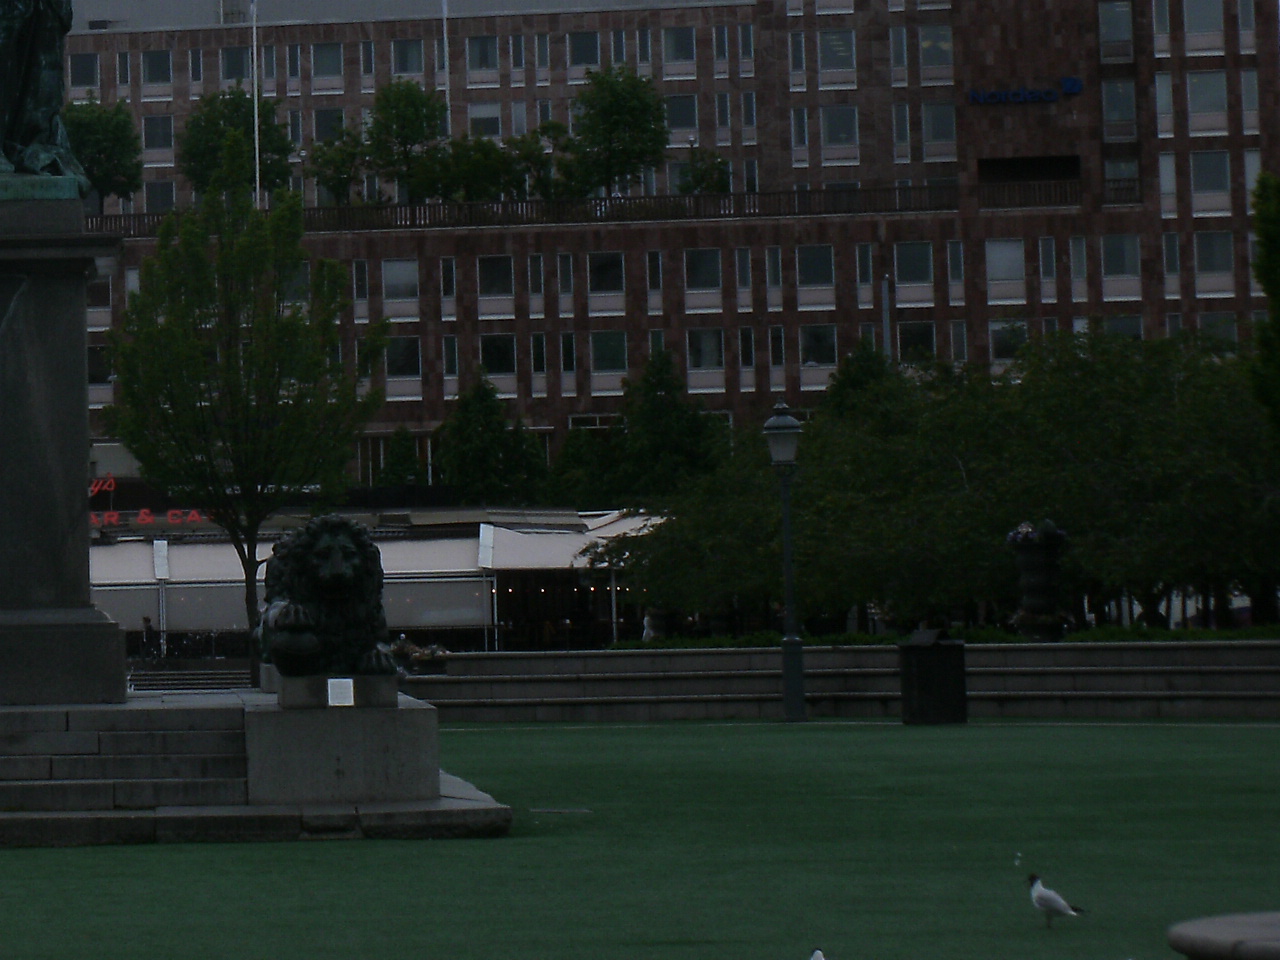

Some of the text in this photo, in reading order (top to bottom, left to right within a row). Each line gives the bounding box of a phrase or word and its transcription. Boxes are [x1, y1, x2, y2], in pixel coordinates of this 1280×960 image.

[970, 87, 1058, 104] Nordea
[90, 472, 117, 496] y's
[89, 511, 120, 526] AR
[136, 508, 156, 525] &
